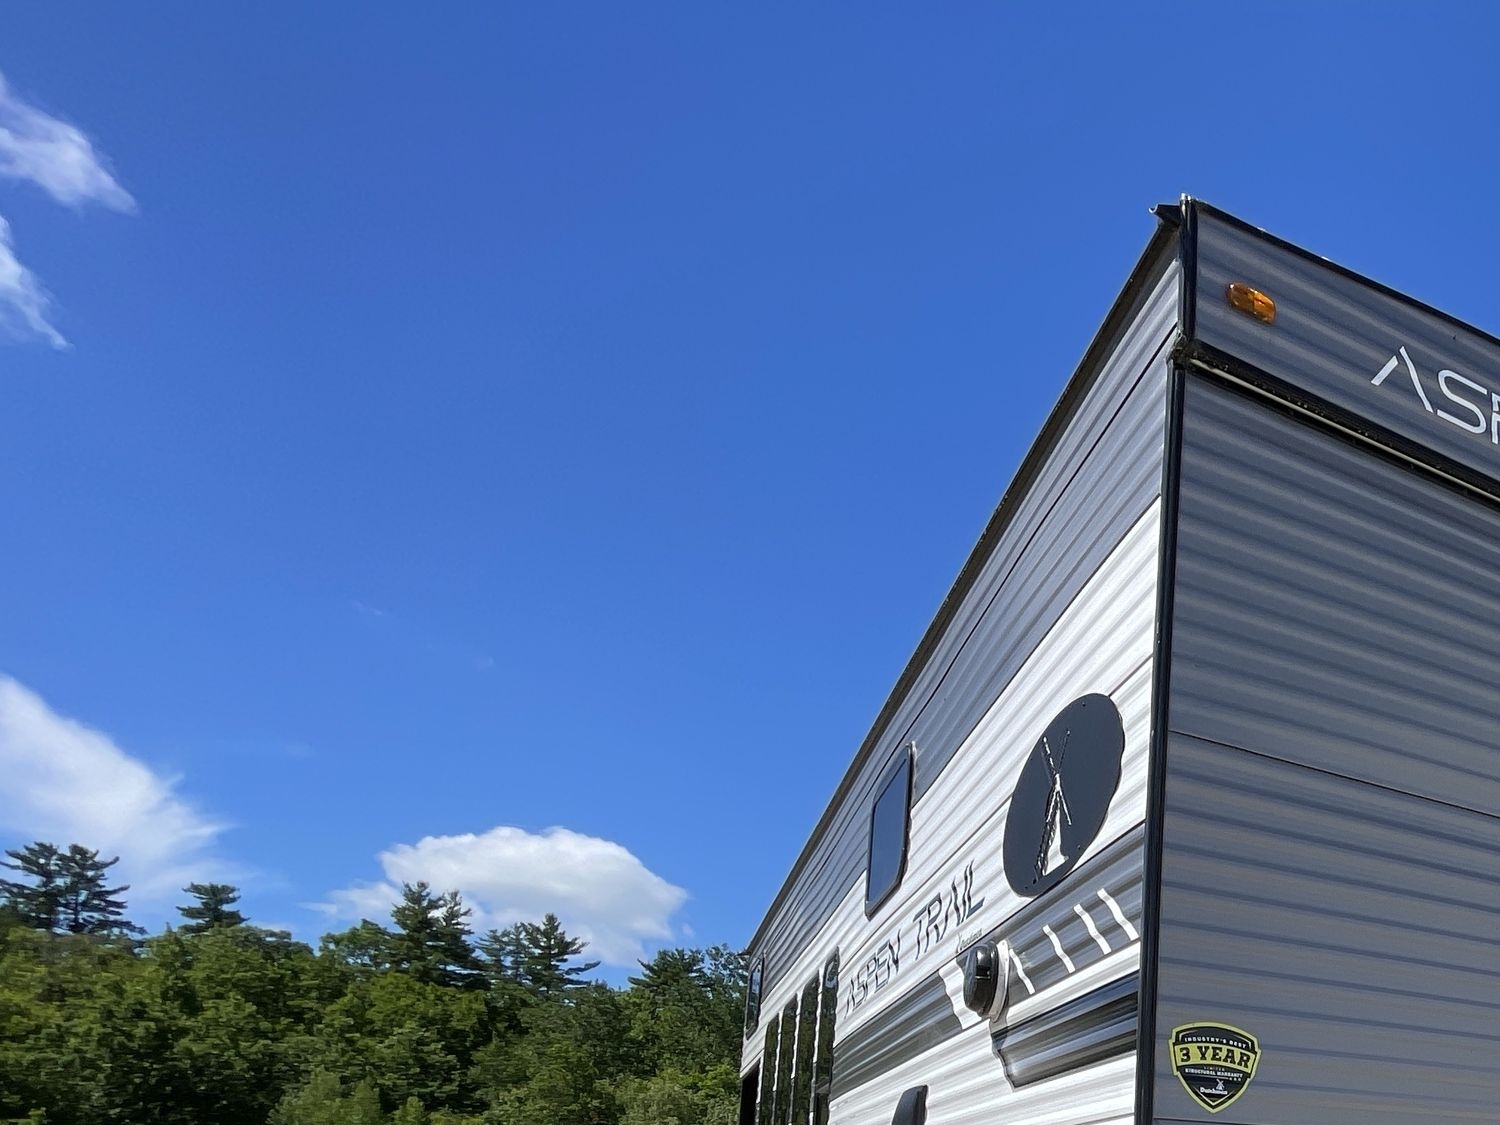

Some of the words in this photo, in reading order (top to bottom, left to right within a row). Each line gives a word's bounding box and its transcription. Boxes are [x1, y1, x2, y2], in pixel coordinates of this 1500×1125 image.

[844, 929, 902, 1019] ASPEN
[913, 859, 986, 961] TRAIL
[1229, 1040, 1247, 1049] BEST
[1179, 1046, 1191, 1063] 3
[1196, 1045, 1251, 1069] YEAR
